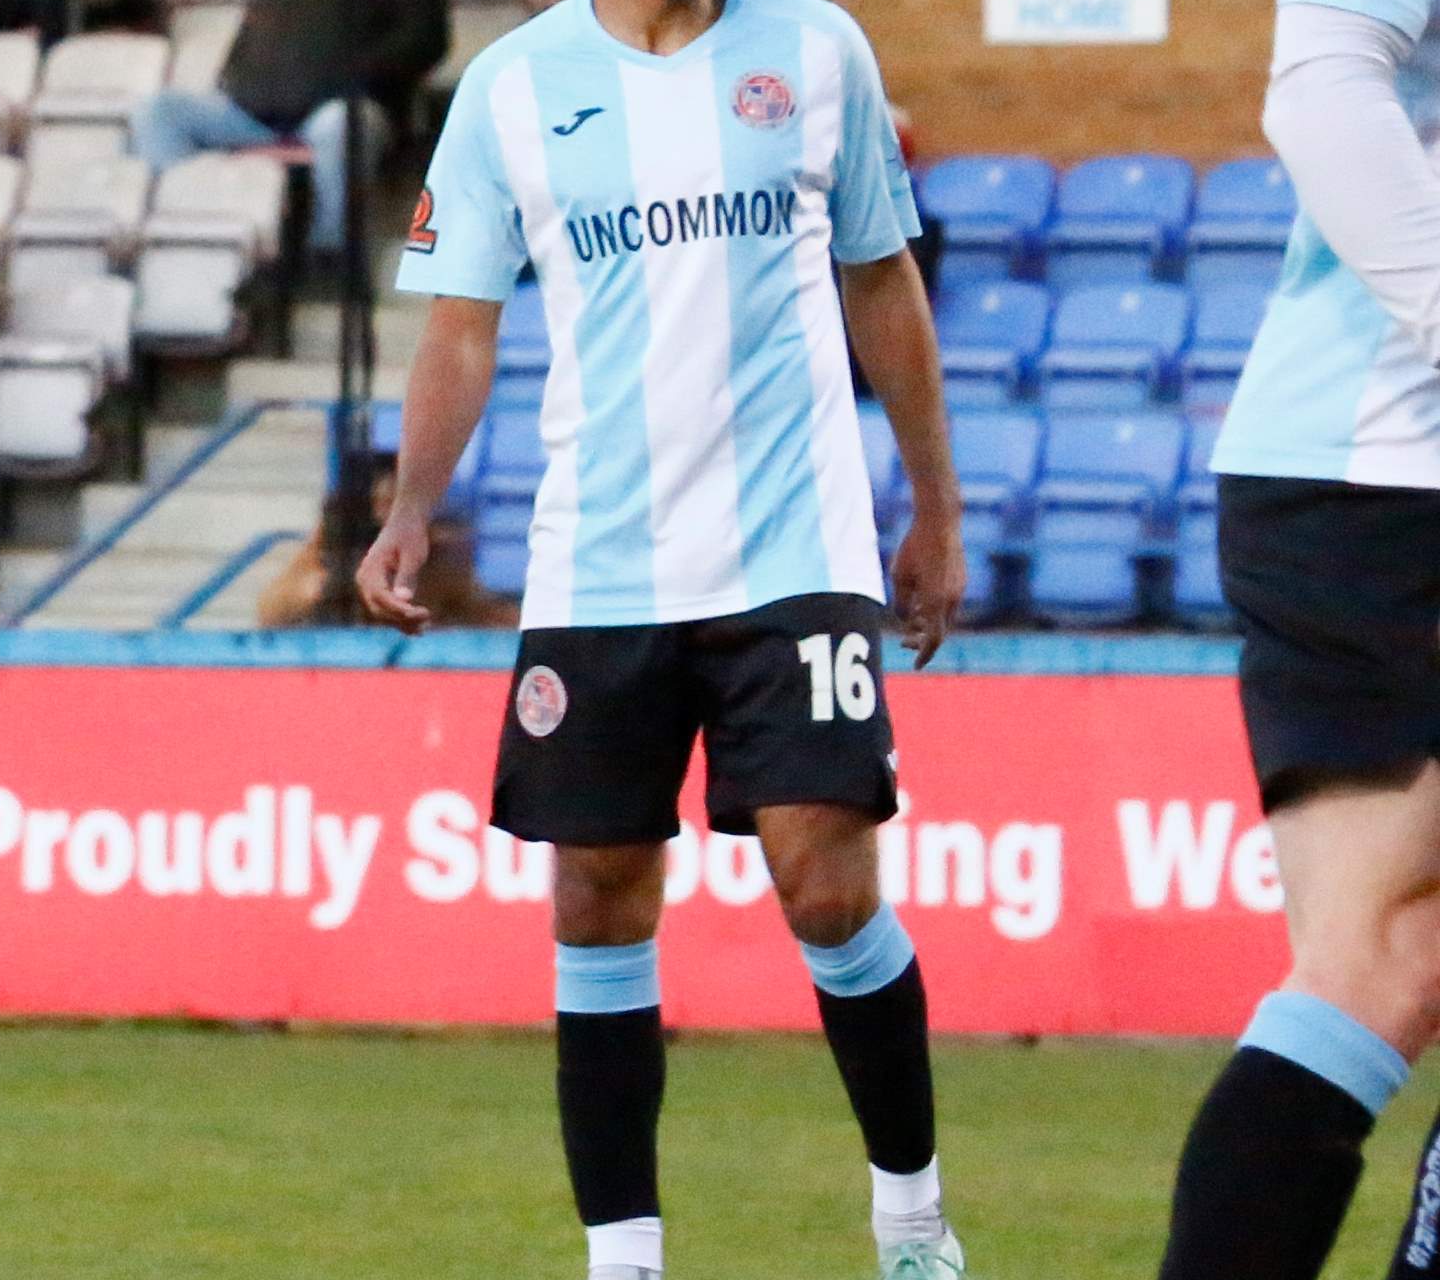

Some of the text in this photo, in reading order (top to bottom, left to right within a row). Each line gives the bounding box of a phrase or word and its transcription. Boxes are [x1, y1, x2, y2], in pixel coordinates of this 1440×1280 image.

[567, 189, 797, 263] UNCOMMON
[797, 631, 878, 722] 16
[403, 789, 1064, 940] Suoing
